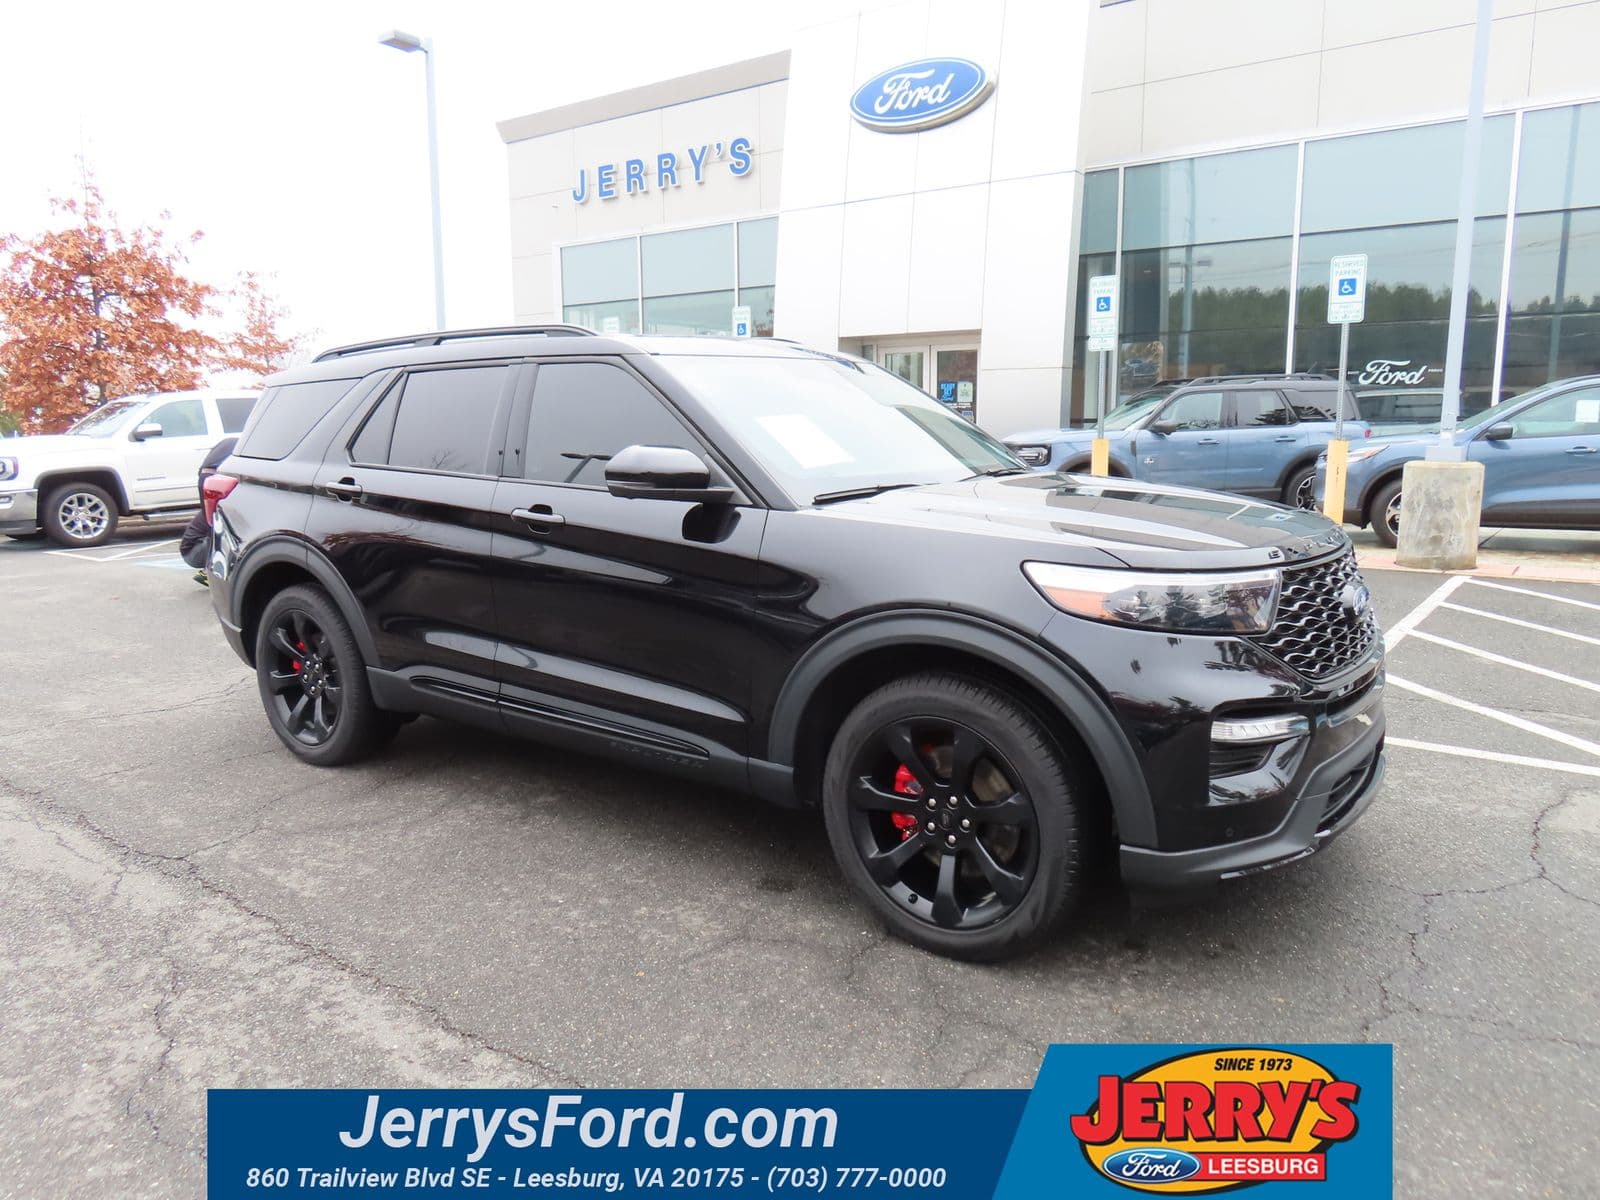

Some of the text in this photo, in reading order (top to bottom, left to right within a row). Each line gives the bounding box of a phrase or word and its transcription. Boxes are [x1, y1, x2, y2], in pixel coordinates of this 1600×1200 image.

[874, 68, 955, 114] Ford
[572, 136, 753, 203] JERRY'S
[1358, 359, 1428, 385] Ford
